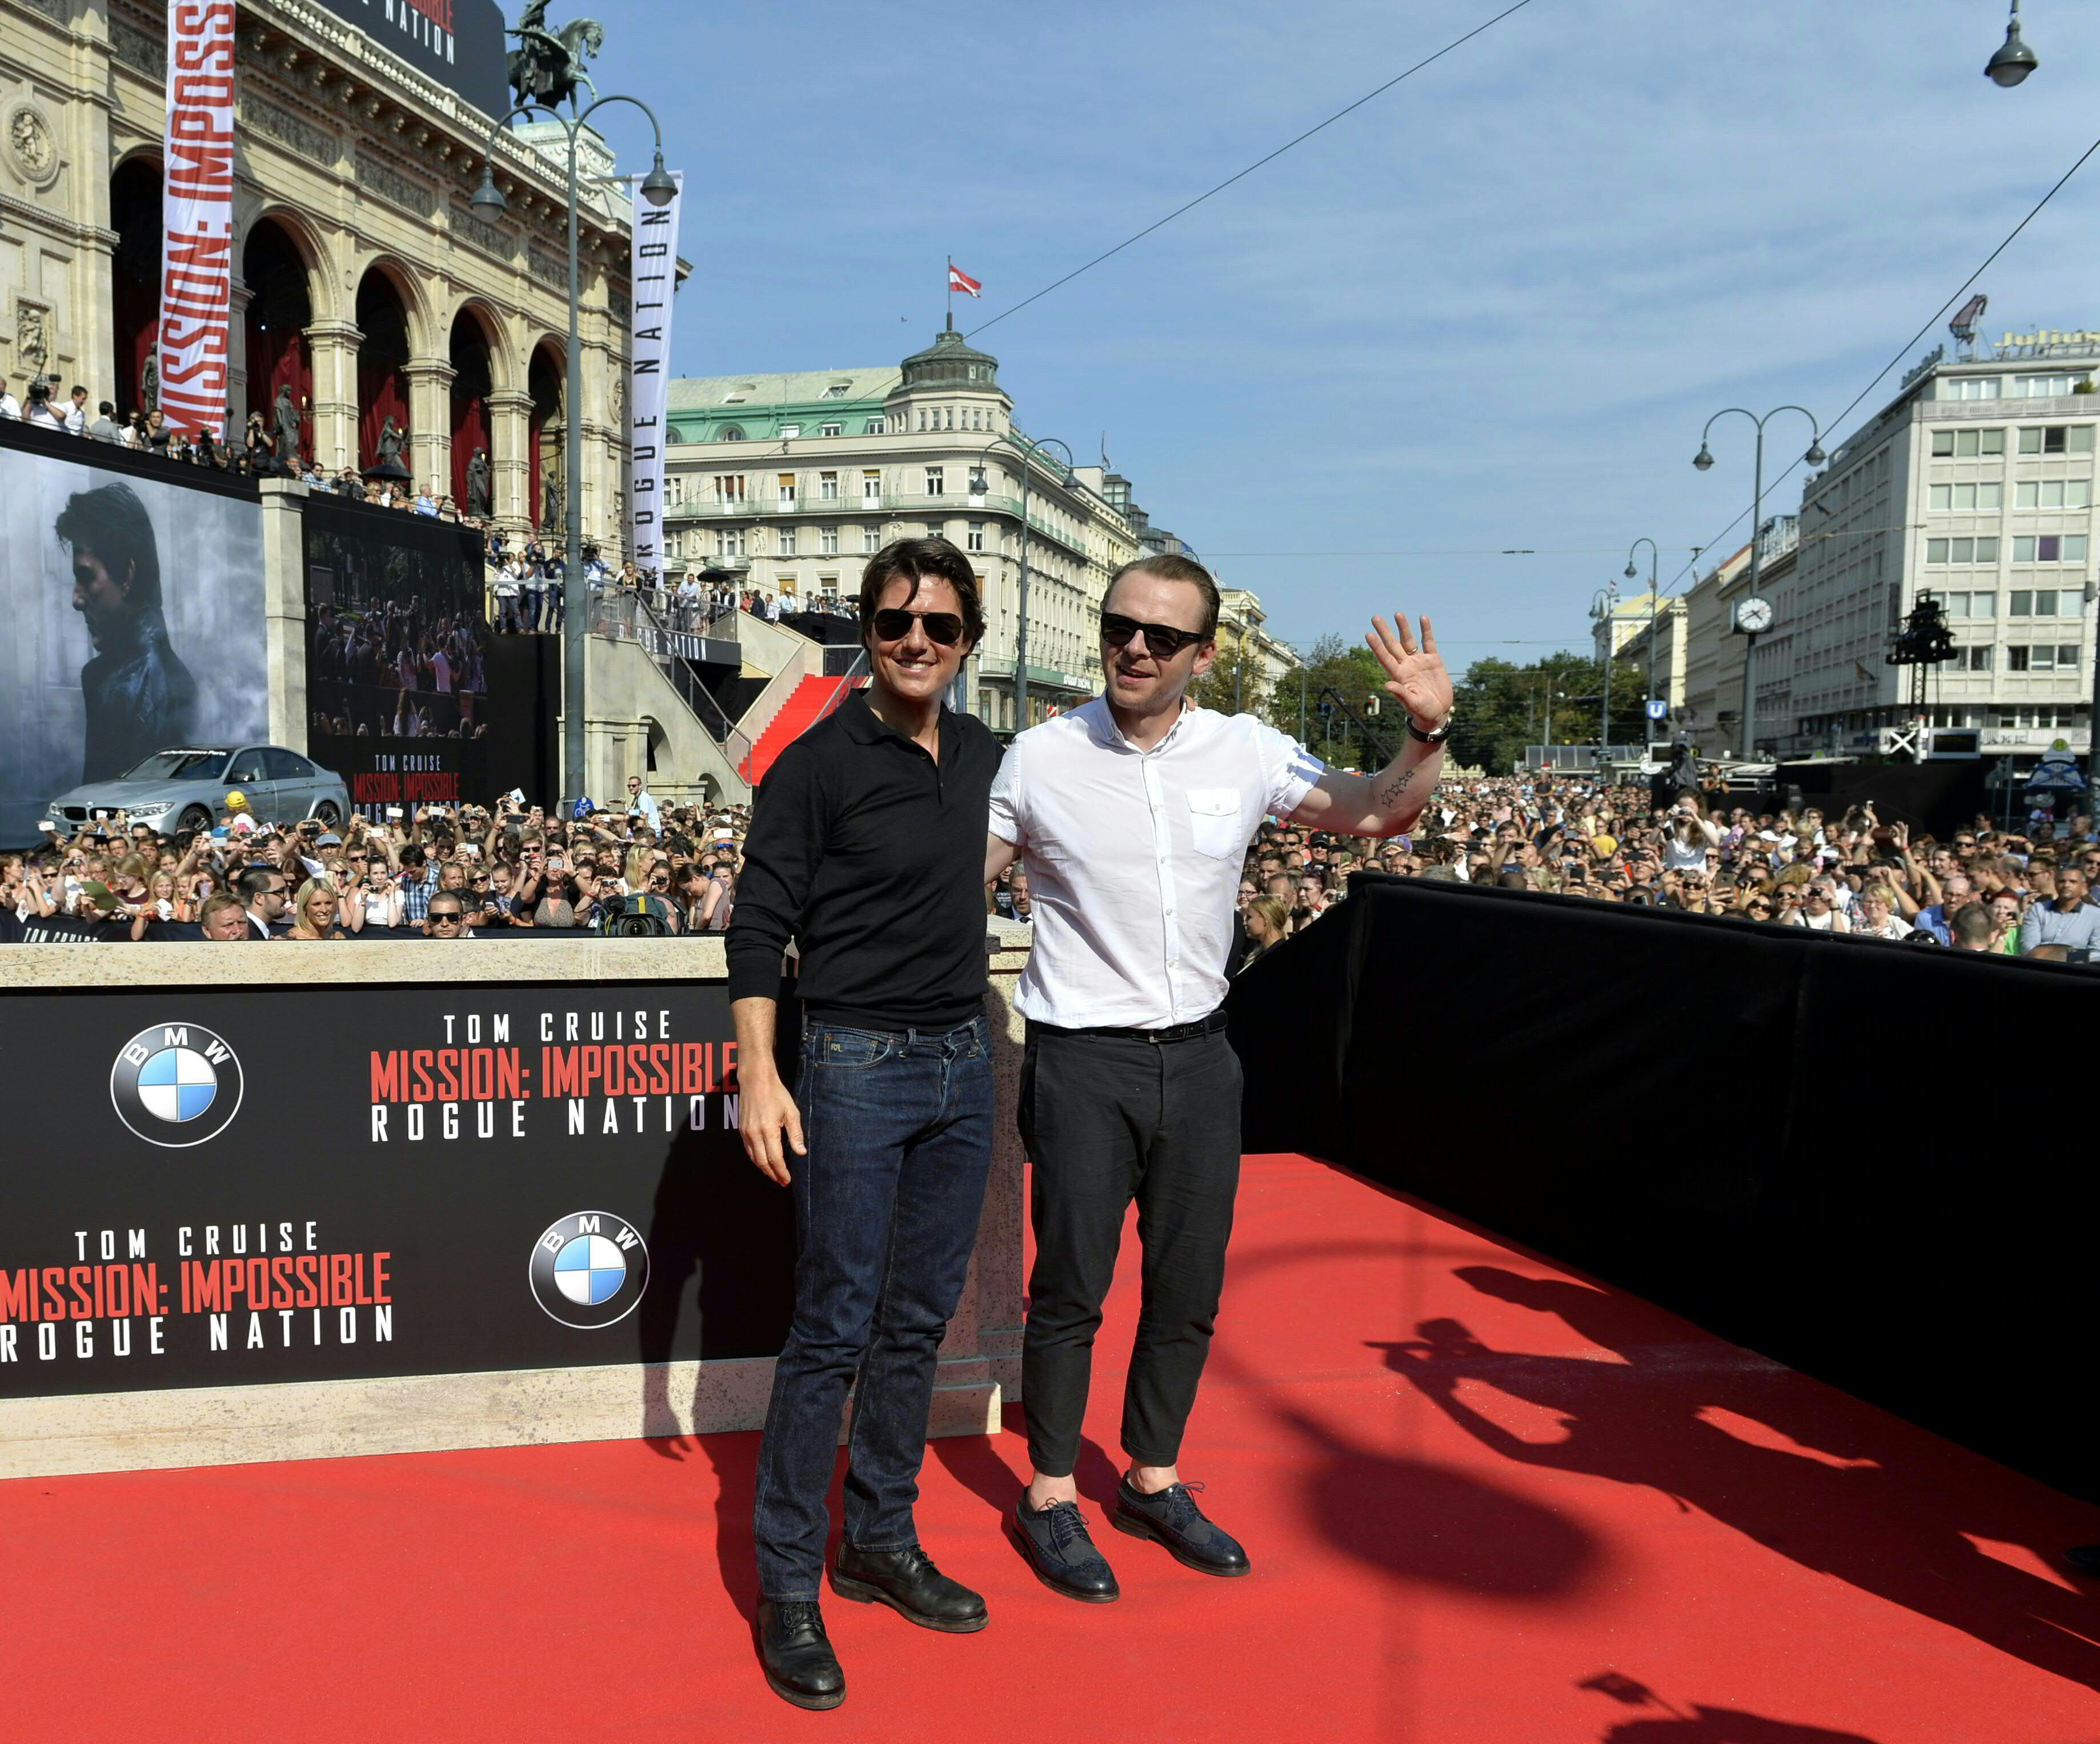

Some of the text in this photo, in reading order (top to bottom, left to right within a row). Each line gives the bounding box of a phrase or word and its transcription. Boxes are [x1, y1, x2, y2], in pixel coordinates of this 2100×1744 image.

[386, 0, 454, 65] NATION
[162, 220, 231, 446] MISSION:
[634, 210, 671, 558] ROGUE NATION
[1650, 704, 1663, 718] U
[375, 754, 440, 771] TOM CRUISE
[353, 773, 459, 802] MISSION: IMPOSSIBLE
[23, 927, 48, 943] TOM
[123, 1027, 231, 1067] BMW
[444, 1010, 670, 1044] TOM CRUISE
[370, 1042, 739, 1103] MISSION: IMPOSSIBLE
[371, 1094, 739, 1142] ROGUE NATION
[75, 1221, 318, 1261] TOM CRUISE
[542, 1215, 639, 1254] BMW
[0, 1252, 392, 1323] MISSION: IMPOSSIBLE
[0, 1305, 392, 1362] ROGUE NATION
